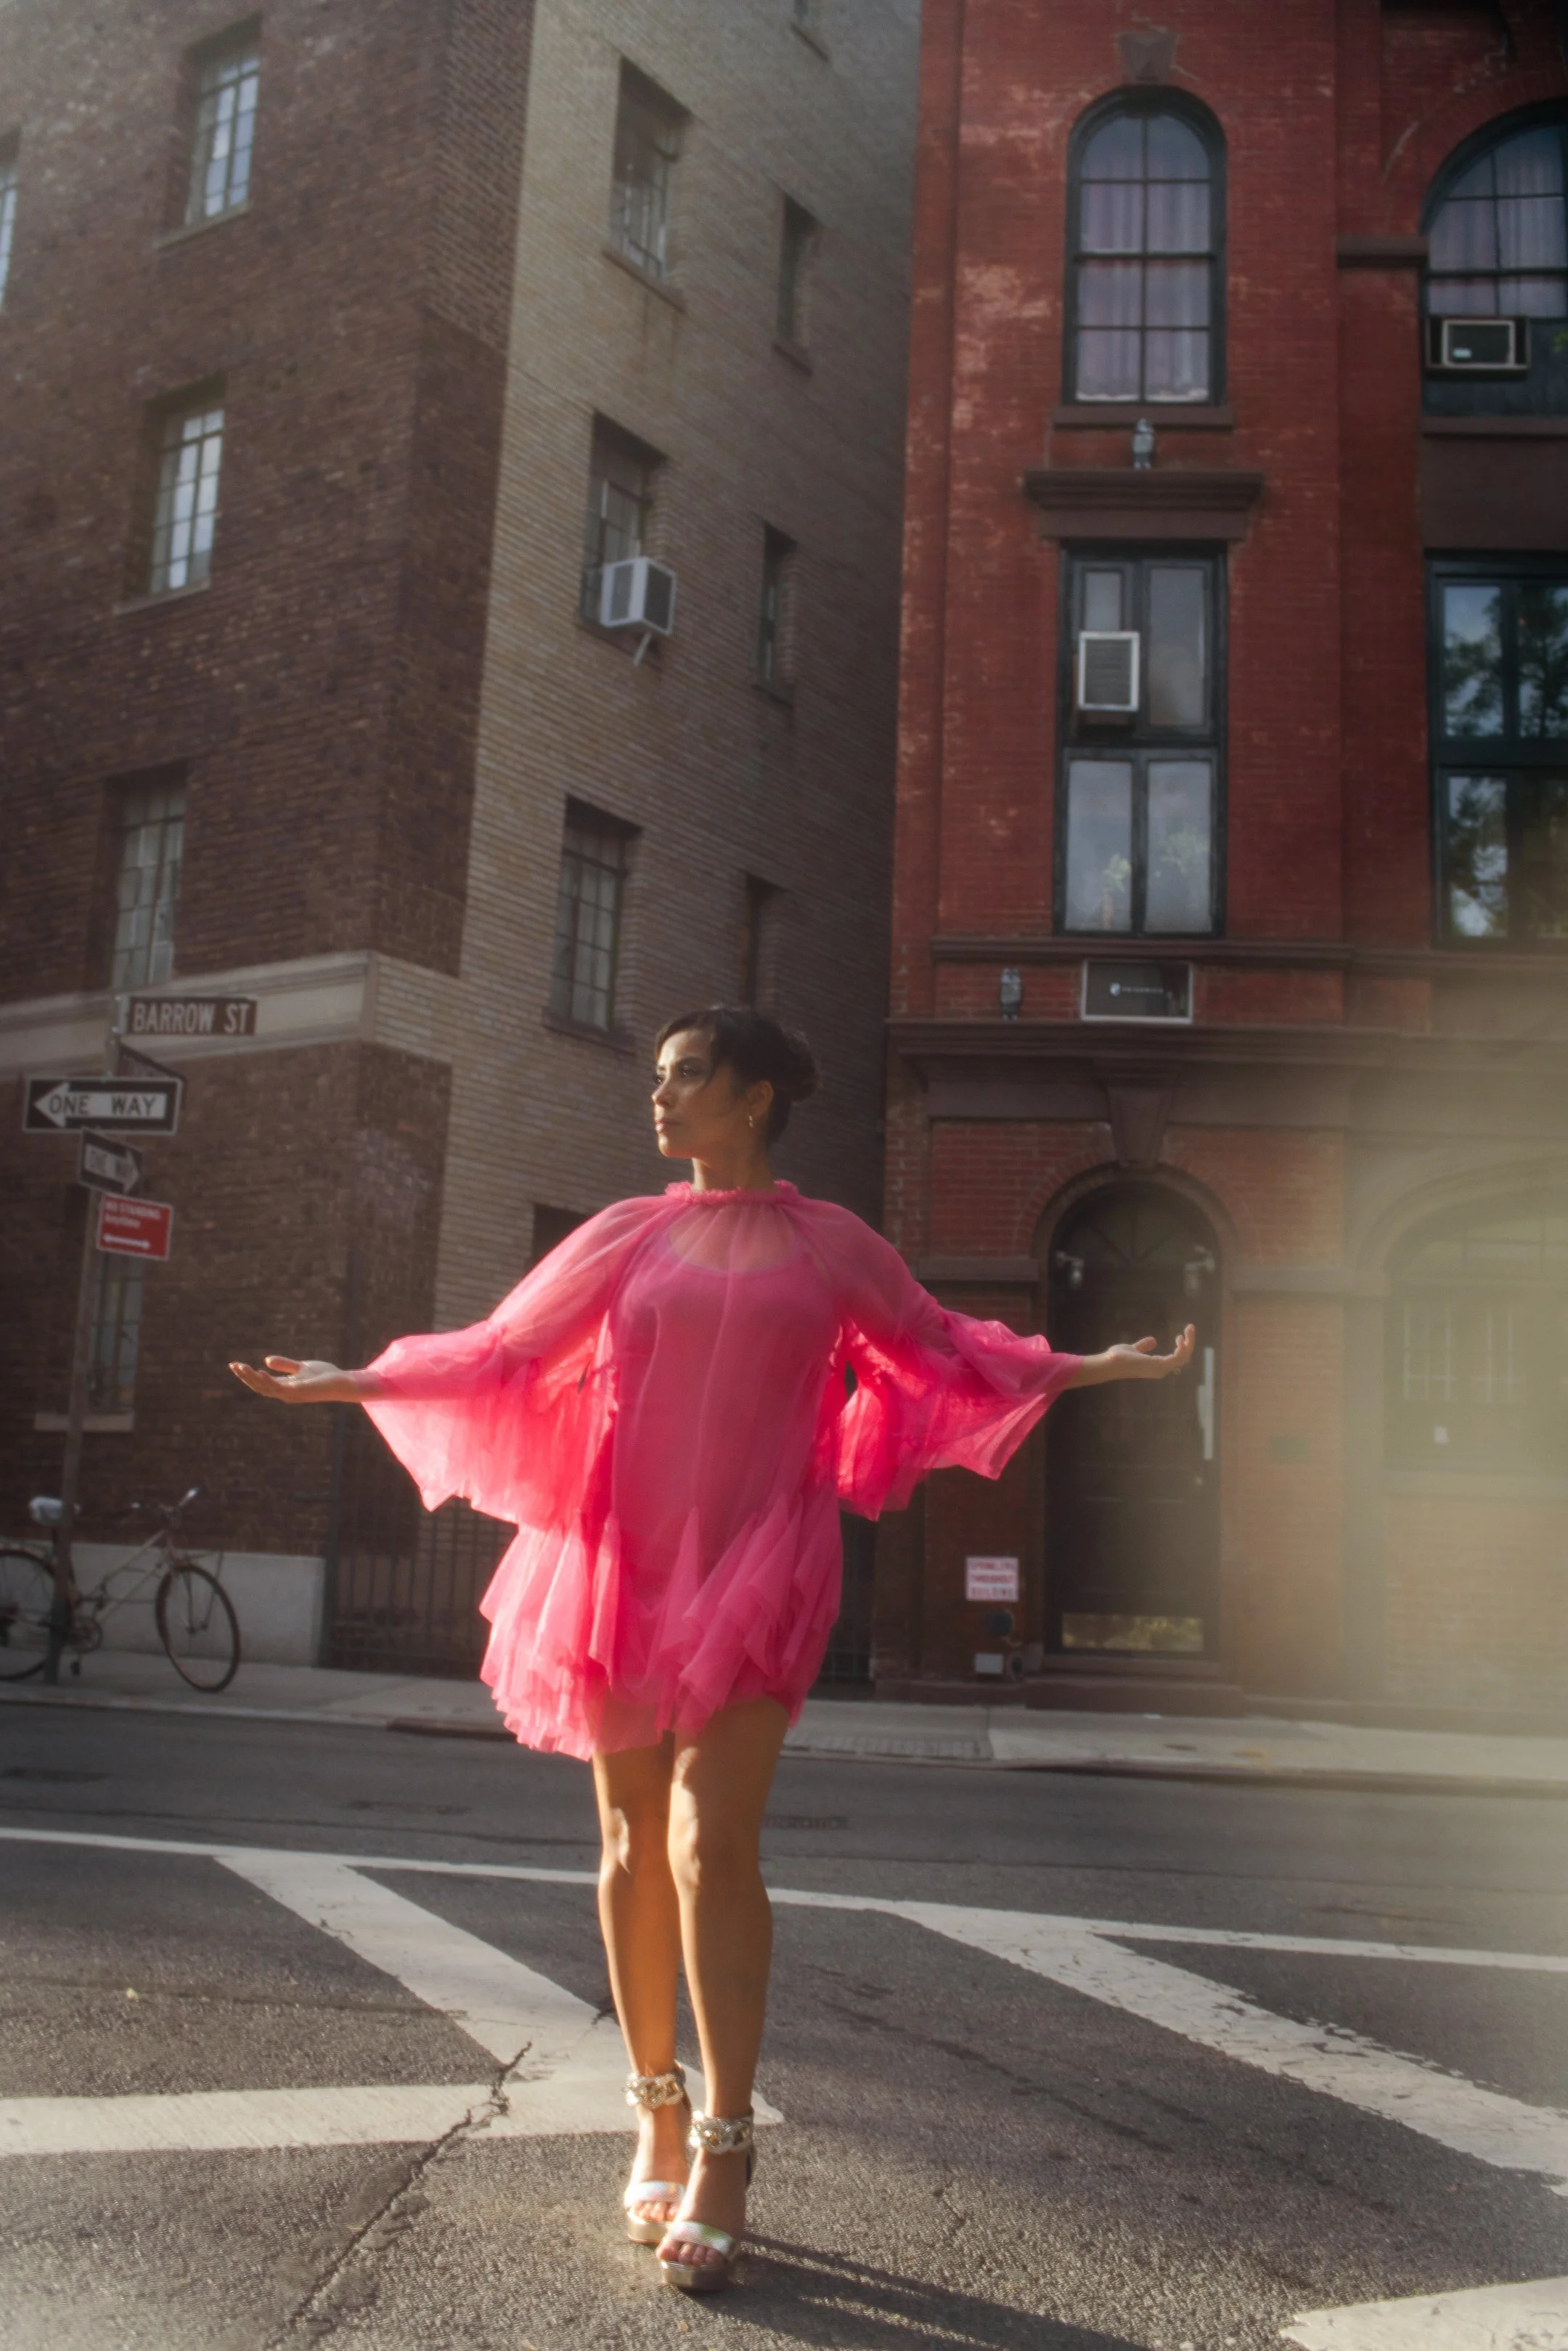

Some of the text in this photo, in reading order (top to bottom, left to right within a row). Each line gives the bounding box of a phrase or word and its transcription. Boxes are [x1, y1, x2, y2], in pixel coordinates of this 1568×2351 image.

[133, 1003, 250, 1033] BARROW ST
[49, 1095, 157, 1116] ONE WAY
